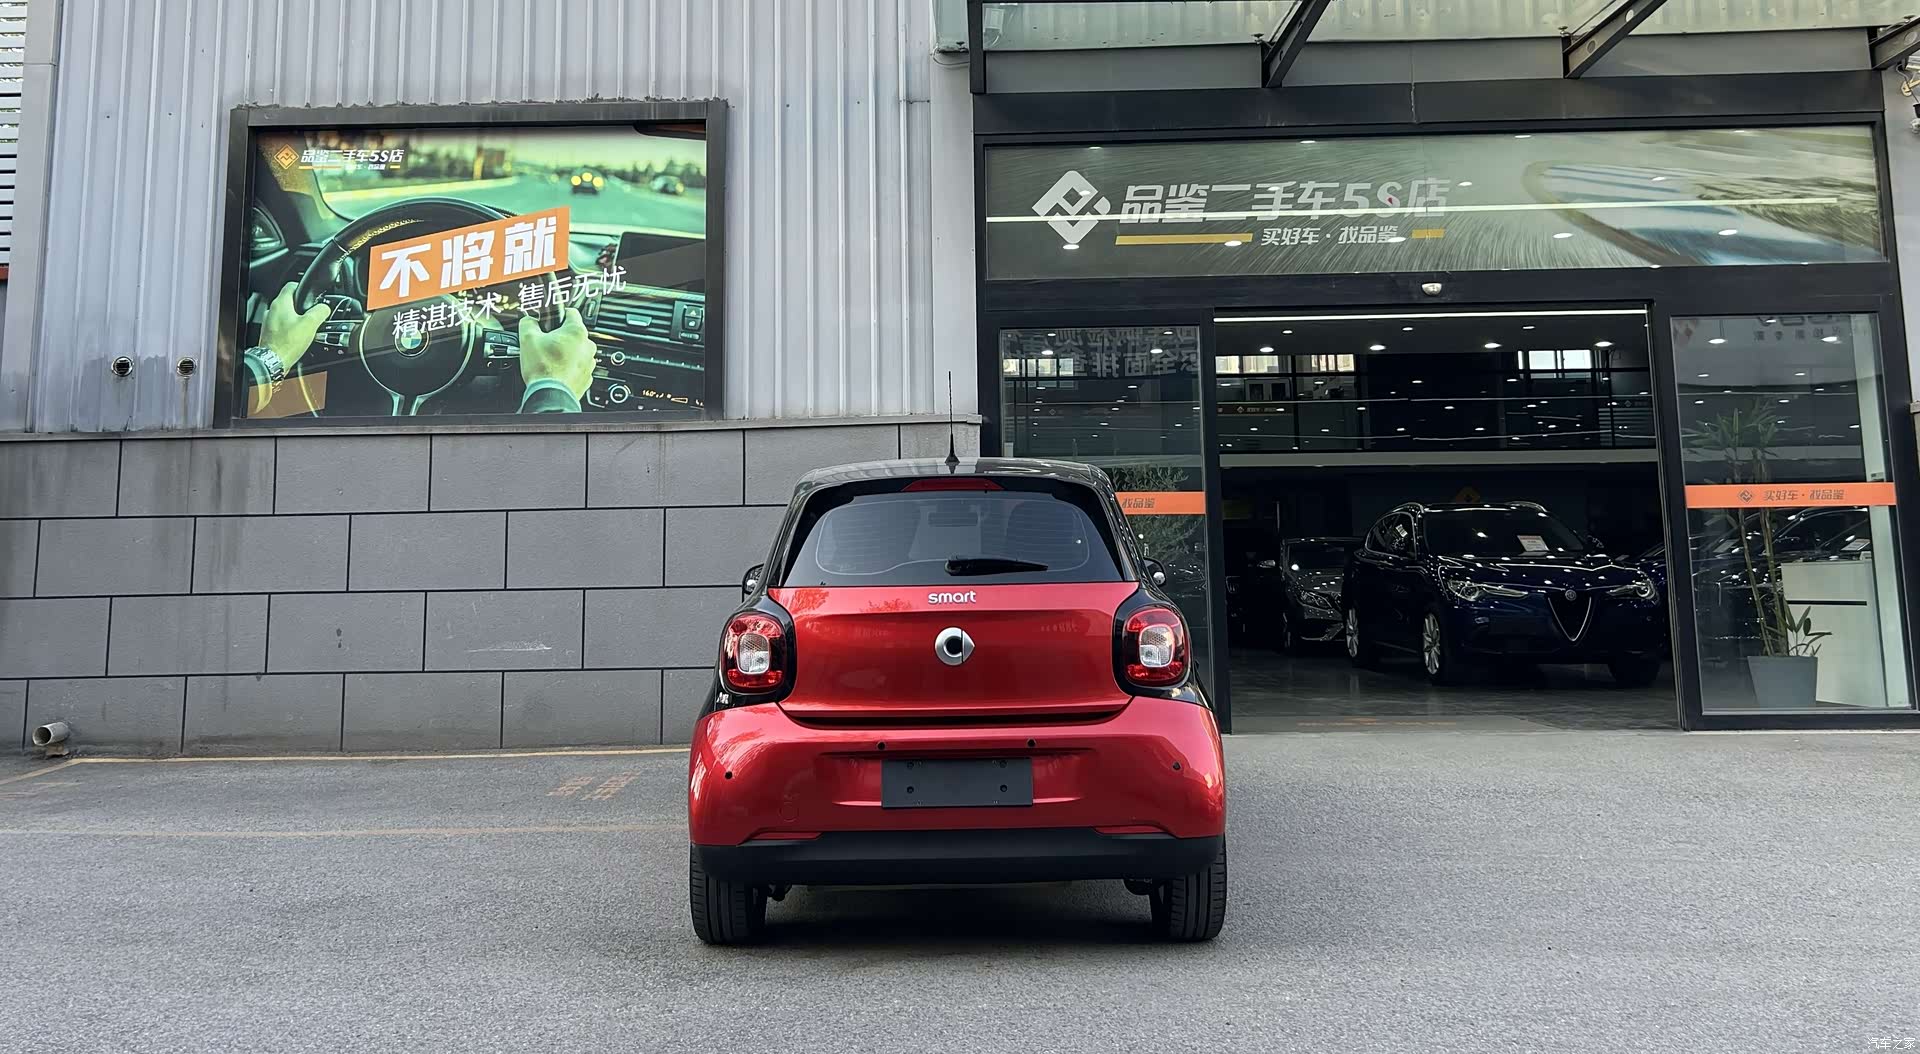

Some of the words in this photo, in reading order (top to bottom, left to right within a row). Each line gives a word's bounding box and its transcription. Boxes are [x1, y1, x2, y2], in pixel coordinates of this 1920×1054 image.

[301, 149, 404, 163] 品鉴二手车5S店
[1119, 180, 1450, 224] 品鉴二手车5S店
[379, 216, 557, 297] 不将就
[392, 291, 502, 339] 精湛技术
[518, 265, 627, 313] 售后无忧
[928, 590, 976, 604] smart
